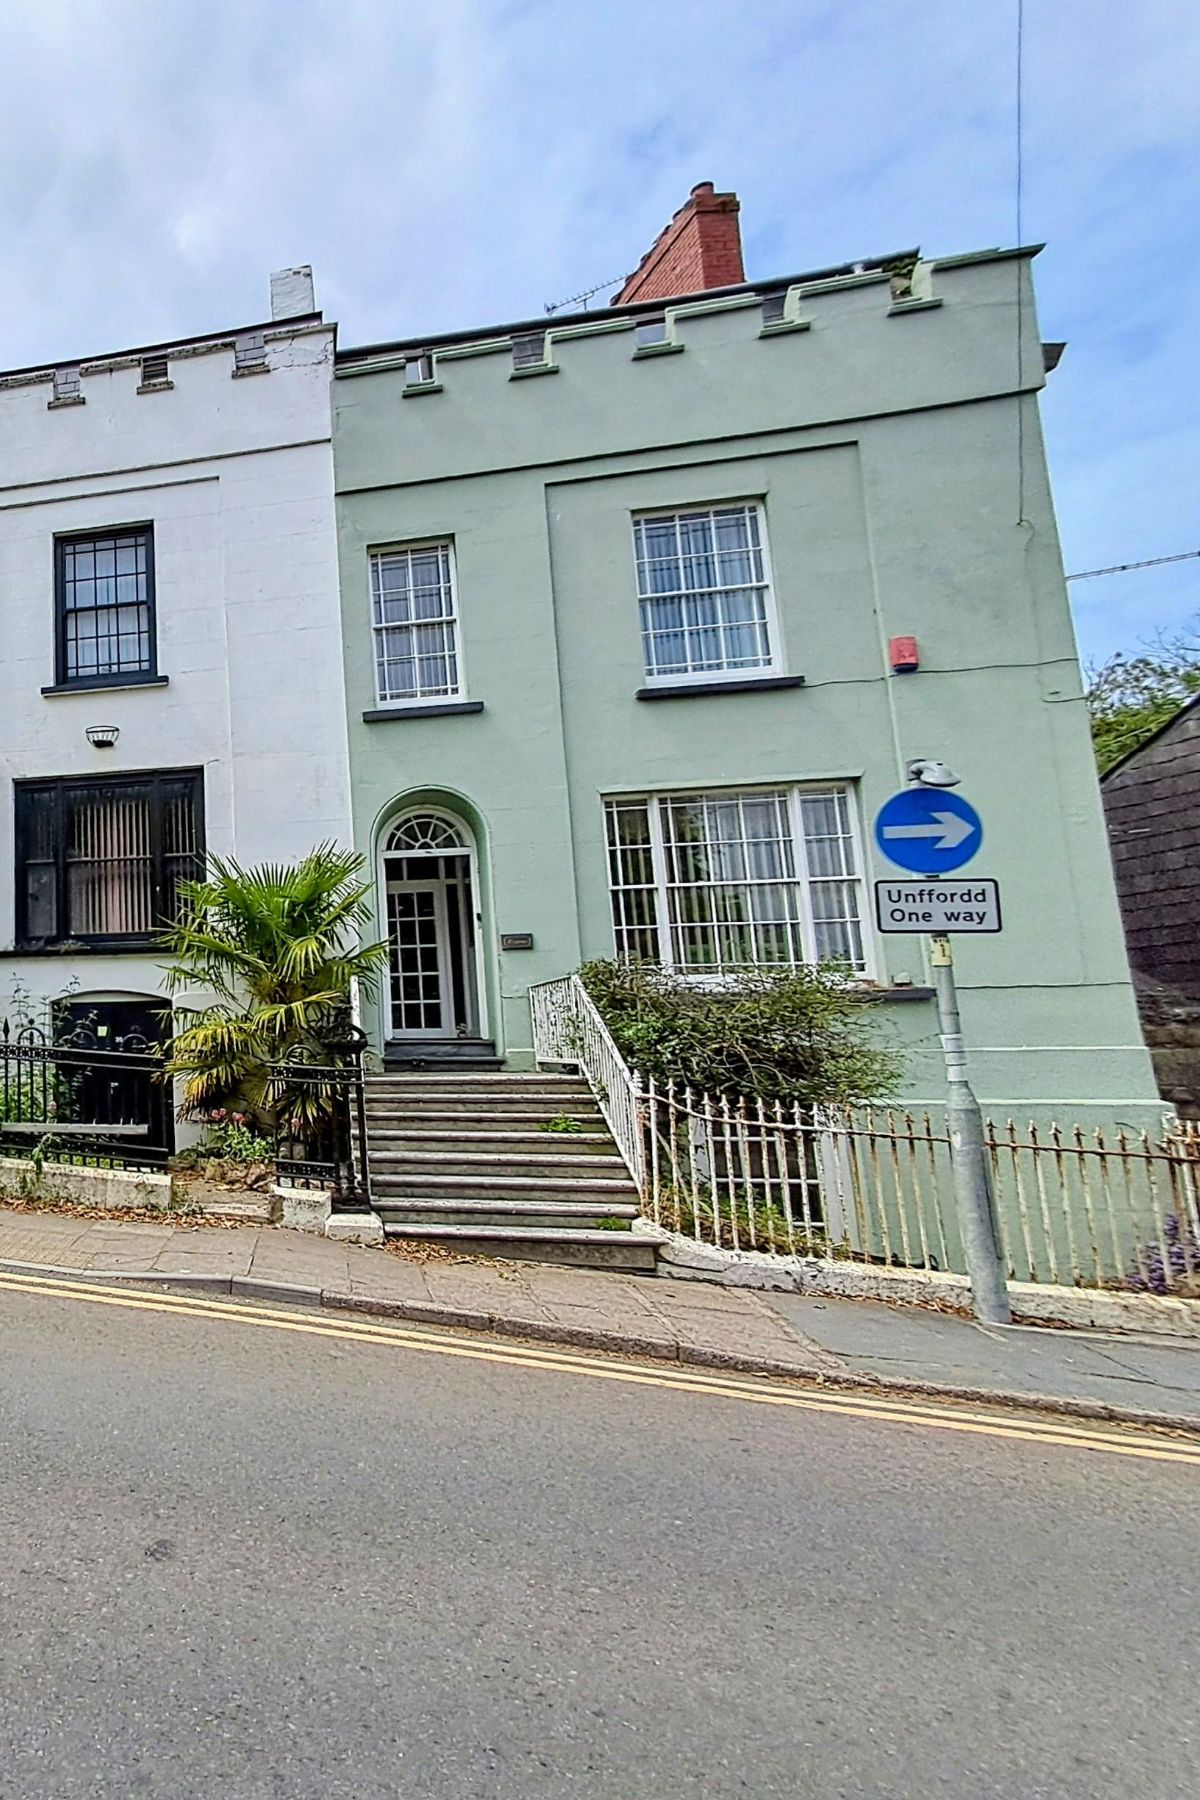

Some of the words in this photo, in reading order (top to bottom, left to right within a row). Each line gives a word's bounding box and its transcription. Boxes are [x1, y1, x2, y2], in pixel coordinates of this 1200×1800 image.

[887, 888, 987, 904] Unffordd
[890, 908, 933, 923] One
[943, 911, 987, 925] way
